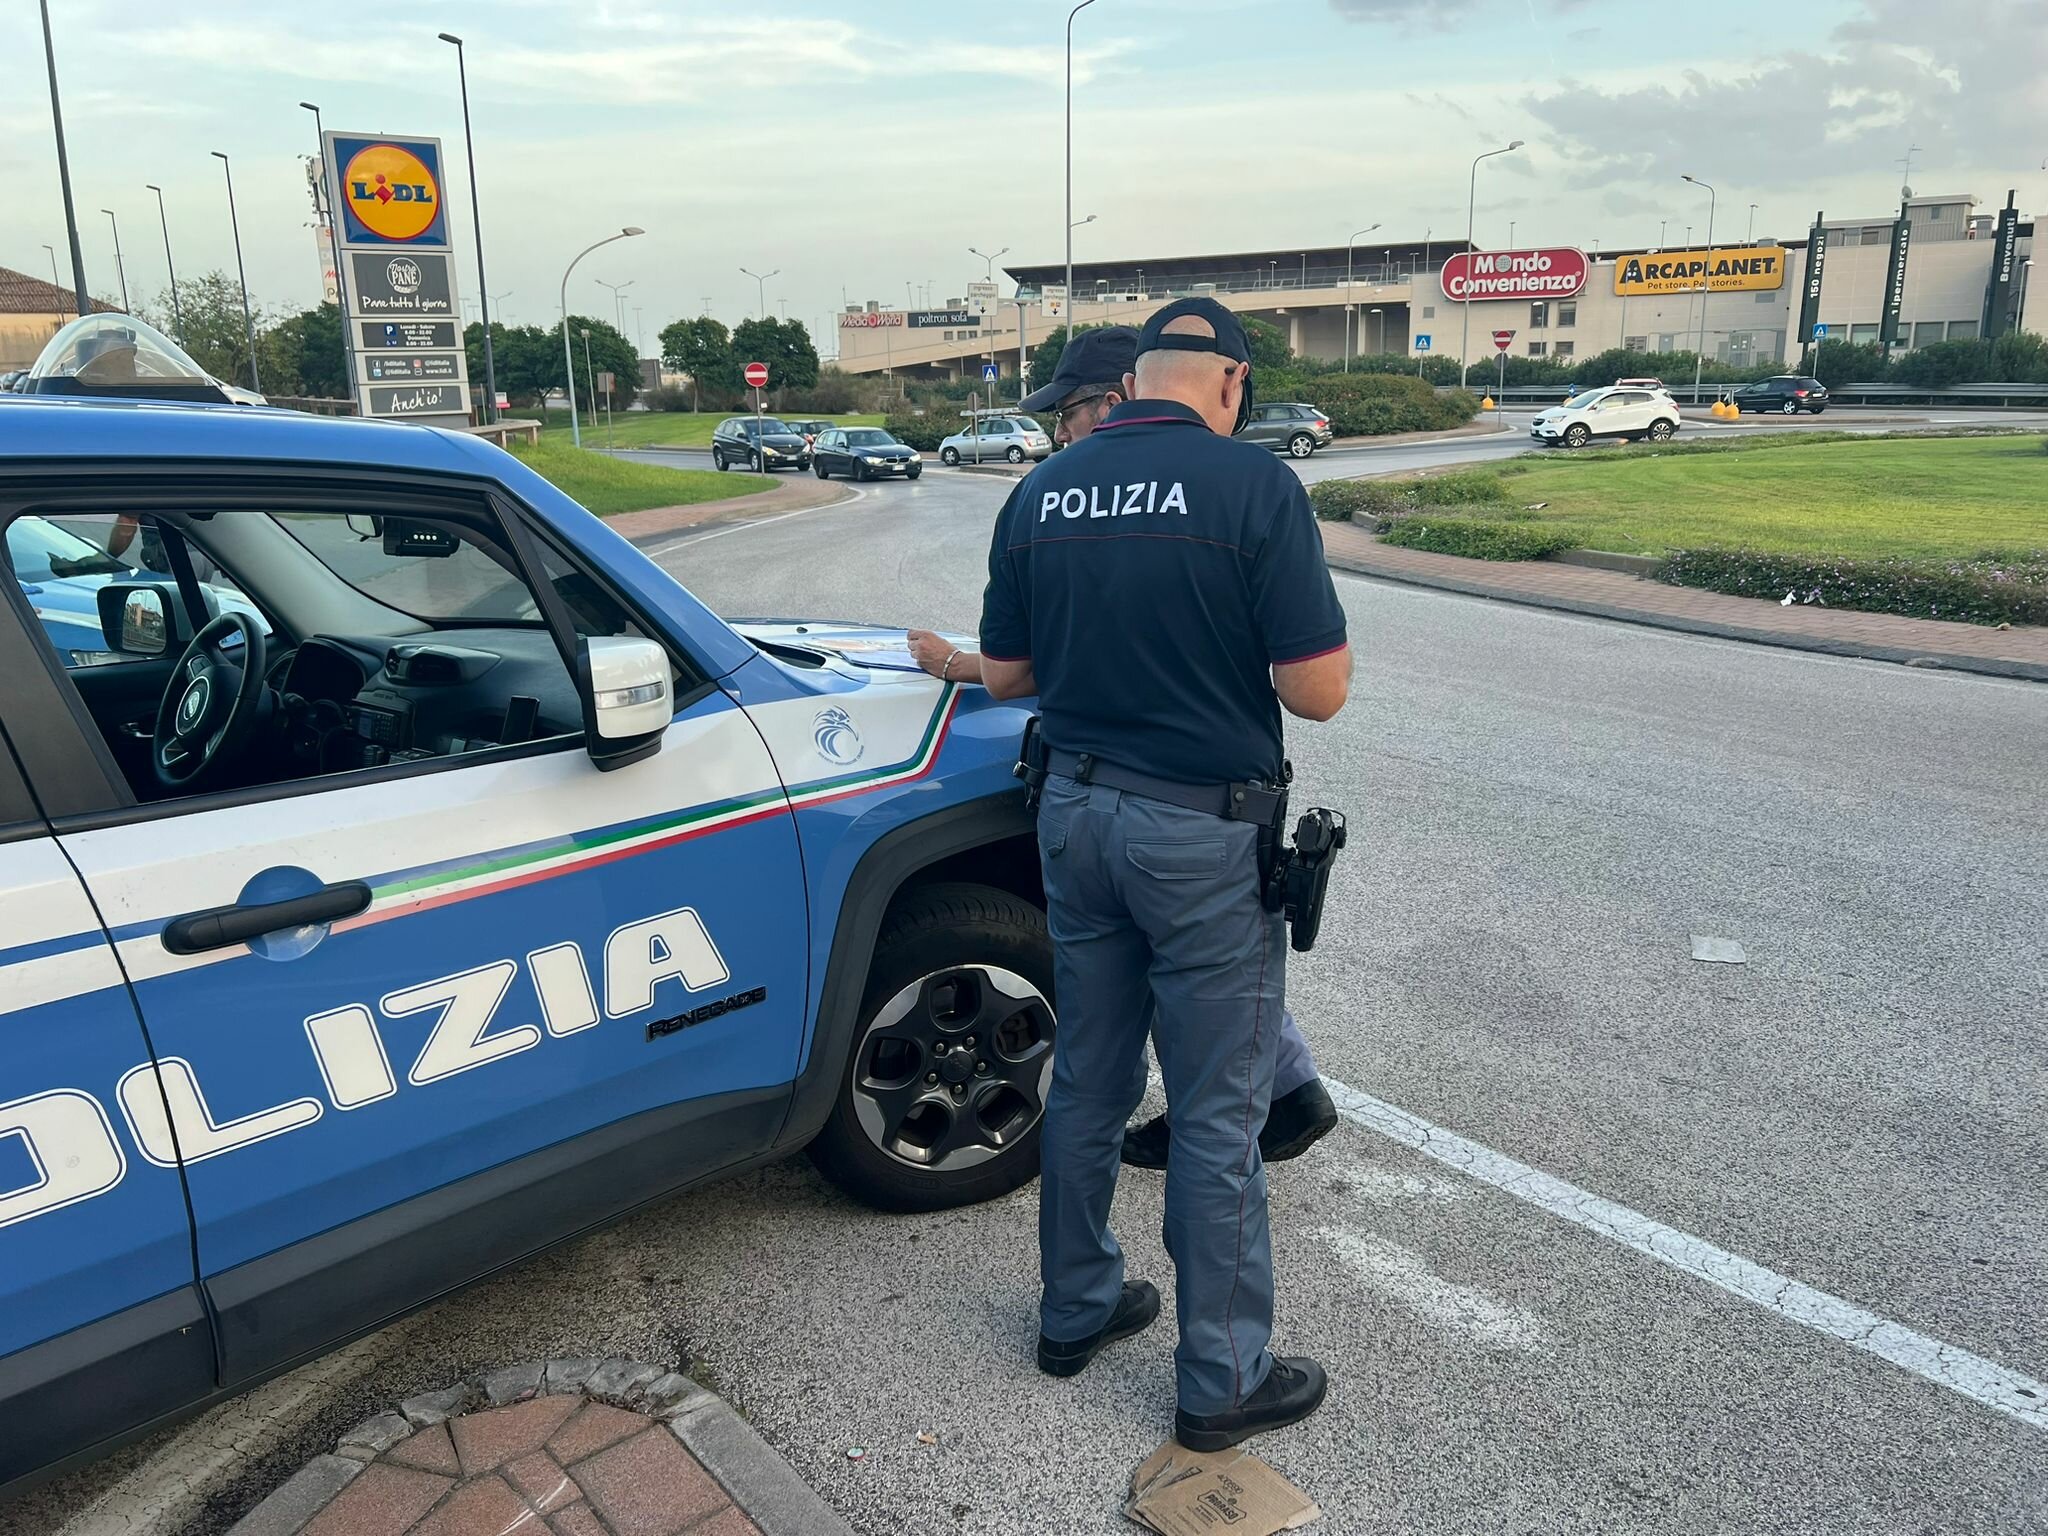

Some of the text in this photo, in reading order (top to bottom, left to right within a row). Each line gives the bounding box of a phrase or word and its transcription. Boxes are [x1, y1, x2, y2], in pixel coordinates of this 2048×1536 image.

[2000, 217, 2016, 282] Benvenuti
[1474, 252, 1552, 274] Mondo
[1810, 235, 1825, 298] 150 negozi
[1892, 229, 1908, 306] ipermercato
[391, 271, 418, 285] PANE
[1450, 272, 1576, 295] Convenienza
[1665, 281, 1691, 289] store.
[1711, 279, 1746, 287] stories.
[362, 295, 388, 309] Pane
[389, 296, 413, 308] tutto
[422, 298, 447, 312] giorno
[386, 325, 394, 335] P
[840, 315, 867, 328] Media
[918, 313, 948, 327] poltron
[391, 387, 442, 413] Anch'io!
[1039, 481, 1188, 523] POLIZIA
